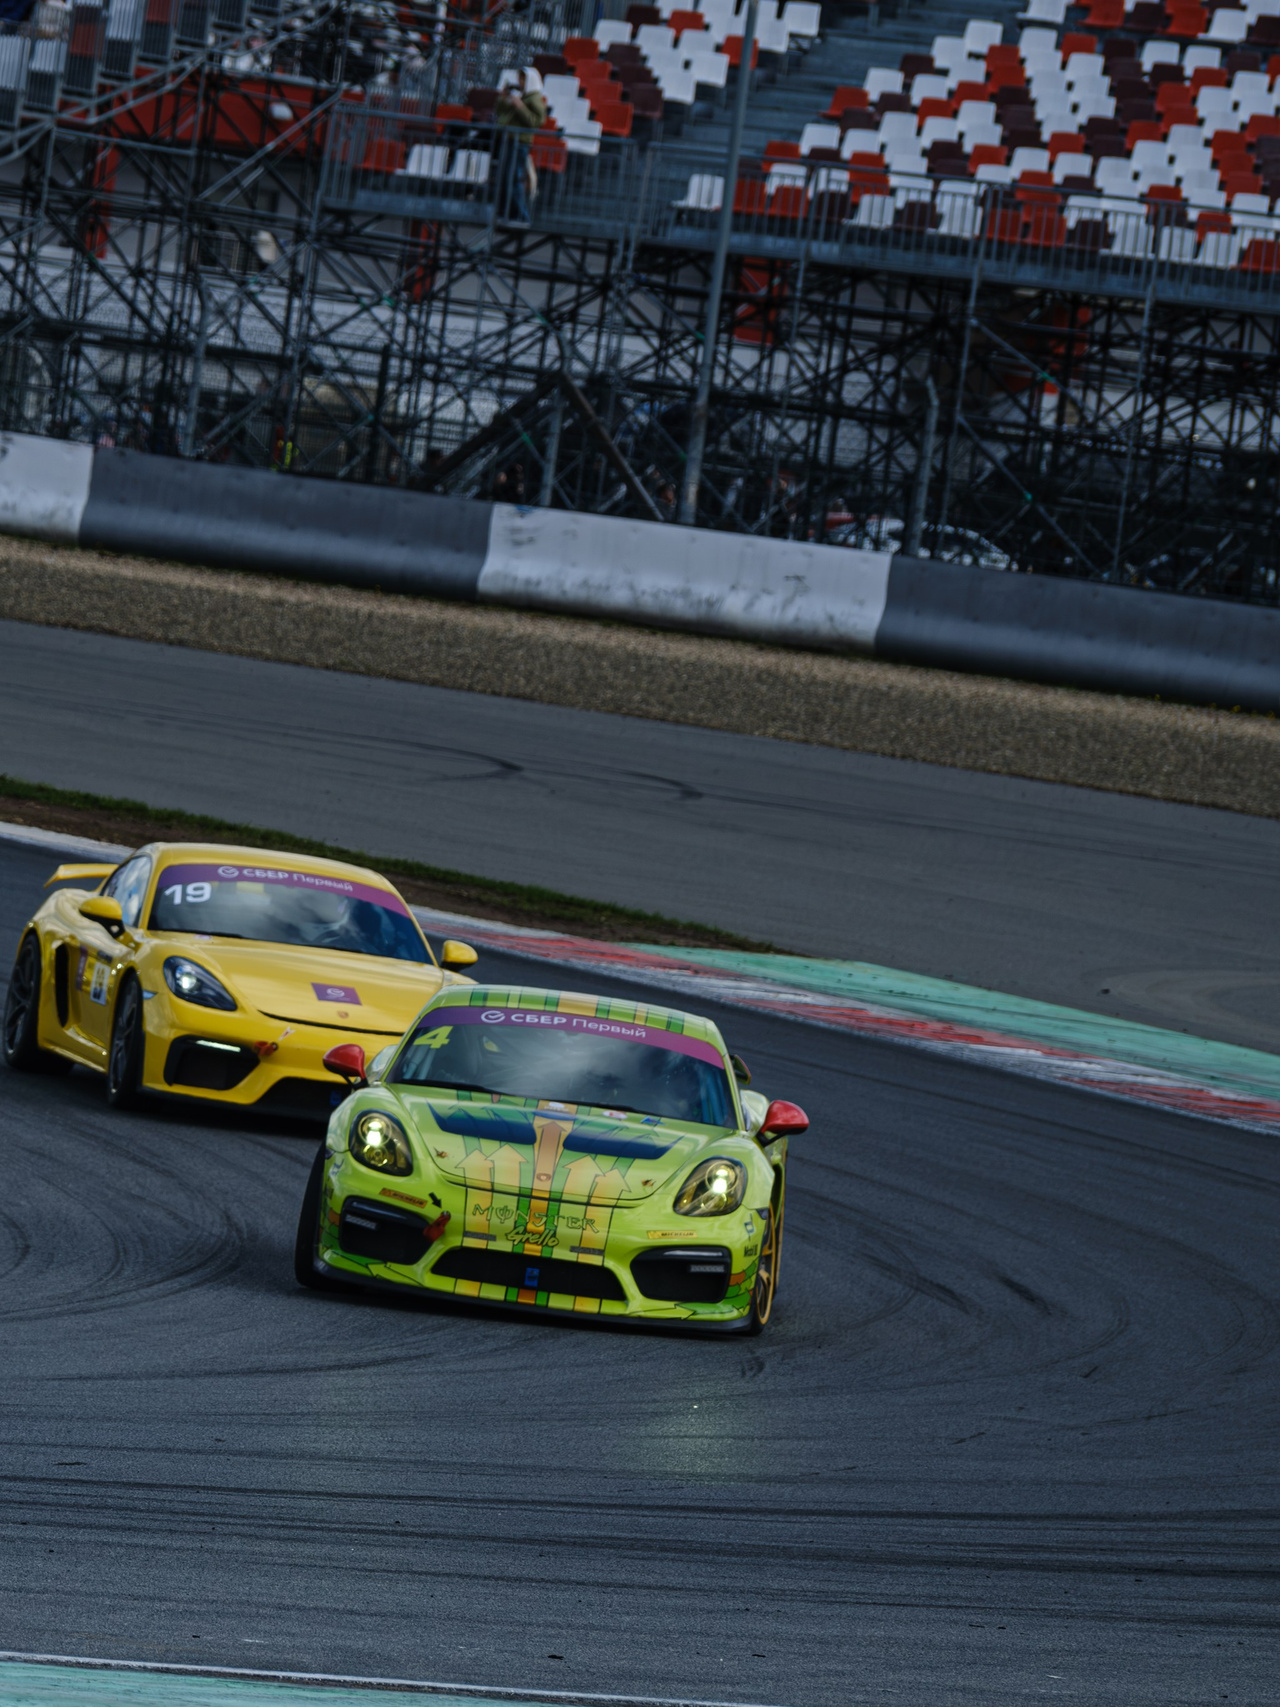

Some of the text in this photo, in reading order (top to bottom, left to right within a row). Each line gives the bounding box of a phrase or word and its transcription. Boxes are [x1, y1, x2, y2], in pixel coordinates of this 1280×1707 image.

[242, 868, 354, 892] СБЕР Первый
[164, 881, 212, 905] 19
[413, 1025, 453, 1049] 4
[510, 1012, 647, 1039] СБЕР Первый
[504, 1226, 560, 1247] Grello
